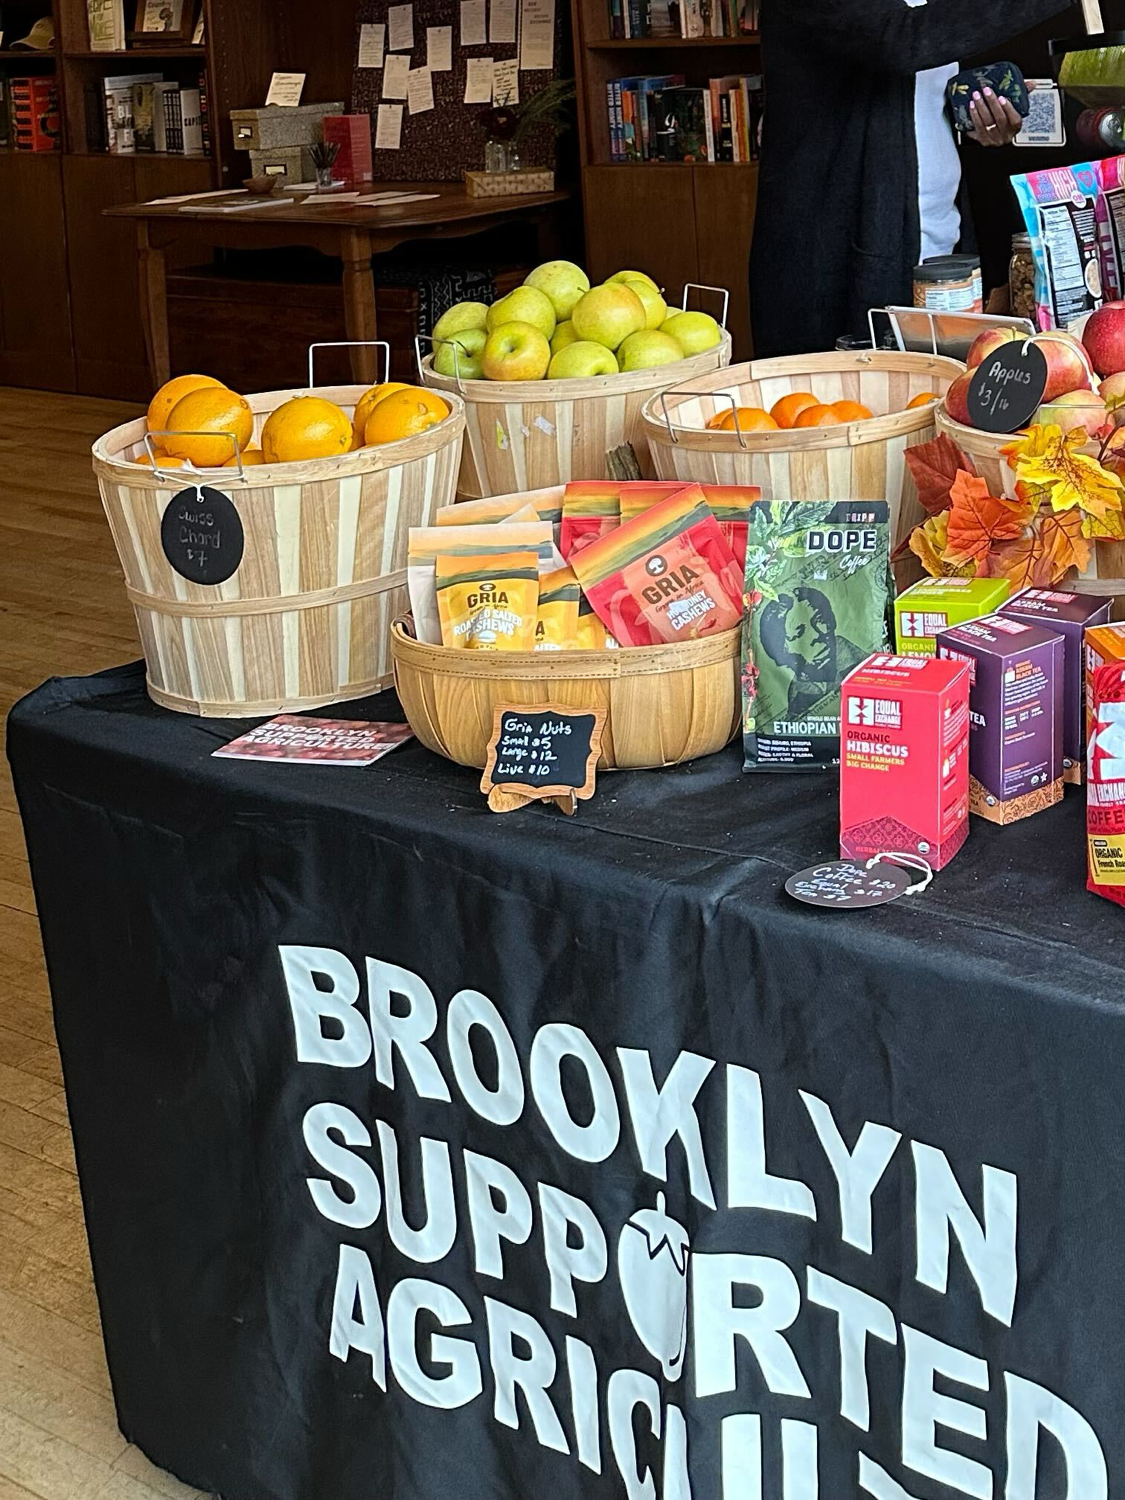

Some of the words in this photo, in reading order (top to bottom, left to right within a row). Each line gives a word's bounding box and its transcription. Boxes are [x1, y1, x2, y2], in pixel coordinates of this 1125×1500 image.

[988, 361, 1031, 385] Apples
[179, 505, 214, 526] Swiss
[806, 529, 878, 553] DOPE
[839, 554, 871, 575] Coffee
[642, 564, 700, 605] GRIA
[467, 591, 509, 609] GRIA
[671, 597, 716, 631] CASHEWS
[924, 613, 948, 626] EQUAL
[875, 699, 902, 715] EQUAL
[505, 718, 533, 733] Gria
[539, 720, 572, 735] Nuts
[969, 710, 987, 727] TEA
[250, 729, 376, 743] SUPPORTED
[261, 723, 377, 737] BROOKLYN
[773, 721, 837, 734] ETHIOPIAN
[847, 730, 891, 743] ORGANIC
[501, 747, 528, 761] Large
[846, 740, 909, 758] HIBISCUS
[846, 752, 870, 762] SMALL
[870, 756, 905, 766] FARMERS
[846, 760, 860, 768] BIG
[860, 762, 890, 772] CHANGE
[497, 763, 524, 775] Live
[1094, 847, 1124, 859] ORGANIC
[812, 867, 863, 885] Coffee
[278, 945, 1018, 1328] BROOKLYN
